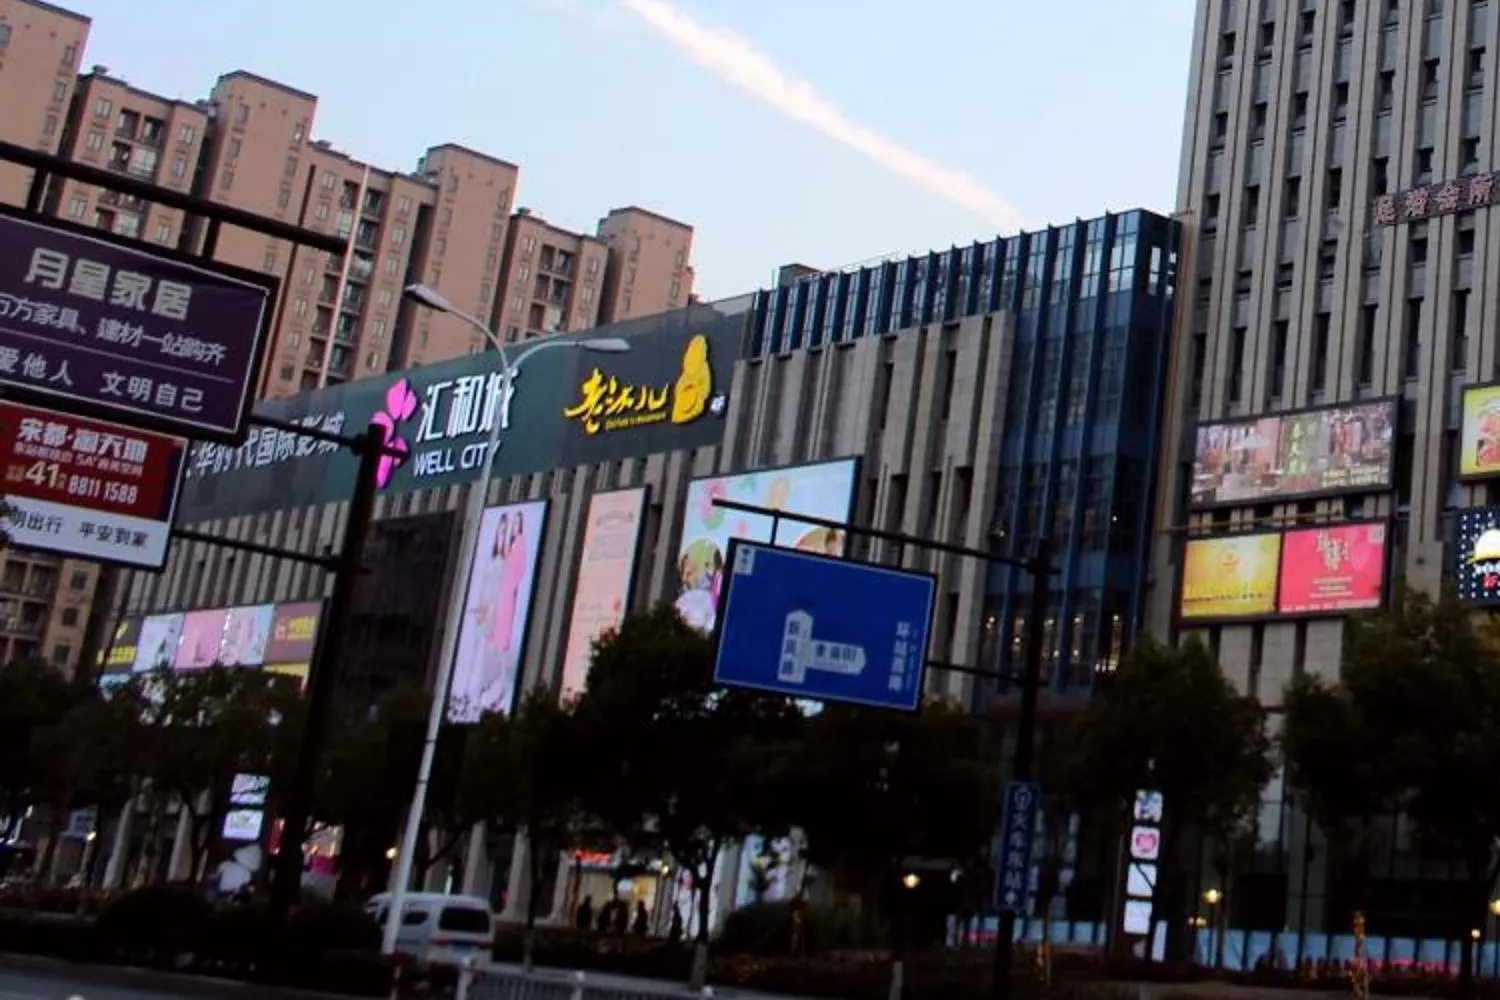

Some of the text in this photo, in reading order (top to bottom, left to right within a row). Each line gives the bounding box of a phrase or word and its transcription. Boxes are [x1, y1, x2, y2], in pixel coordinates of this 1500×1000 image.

[24, 246, 192, 321] 月星家居
[99, 369, 205, 413] 文明自己
[415, 367, 518, 442] 汇和城
[413, 448, 454, 476] WELL
